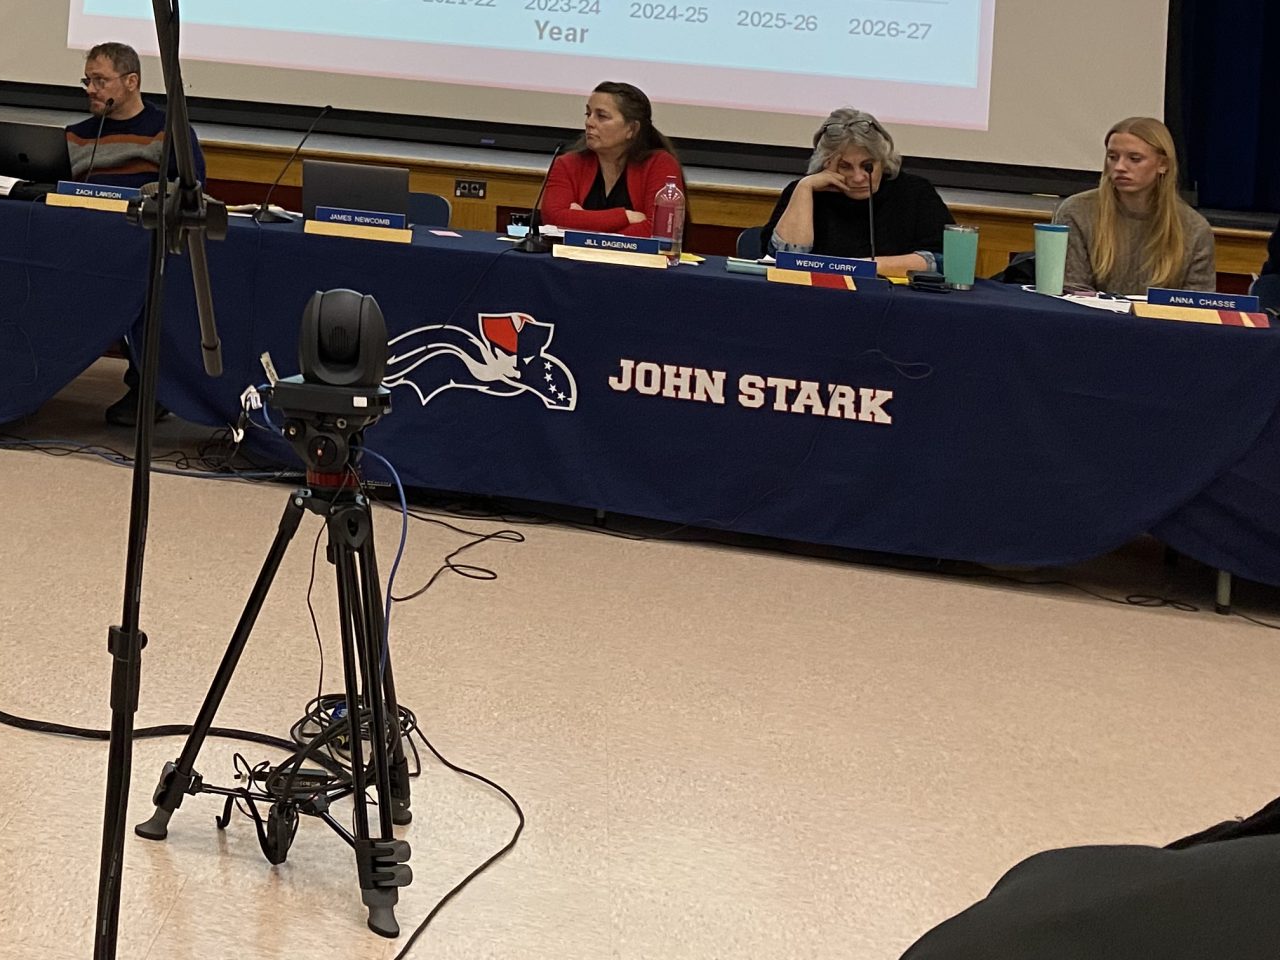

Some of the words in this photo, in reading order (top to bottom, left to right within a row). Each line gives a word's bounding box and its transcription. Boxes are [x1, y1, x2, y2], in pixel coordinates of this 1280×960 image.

[629, 2, 709, 23] 2024-25
[736, 10, 818, 32] 2025-26
[534, 19, 589, 43] Year
[848, 18, 932, 40] 2026-27
[75, 188, 93, 196] ZACH
[330, 214, 352, 222] JAMES
[354, 216, 390, 225] NEWCOMB
[601, 240, 637, 250] DAGENAIS
[796, 259, 825, 269] WENDY
[829, 263, 857, 272] CURRY
[1169, 296, 1194, 304] ANNA
[1199, 298, 1236, 308] CHASSE
[608, 358, 727, 405] JOHN
[737, 373, 894, 425] STARK
